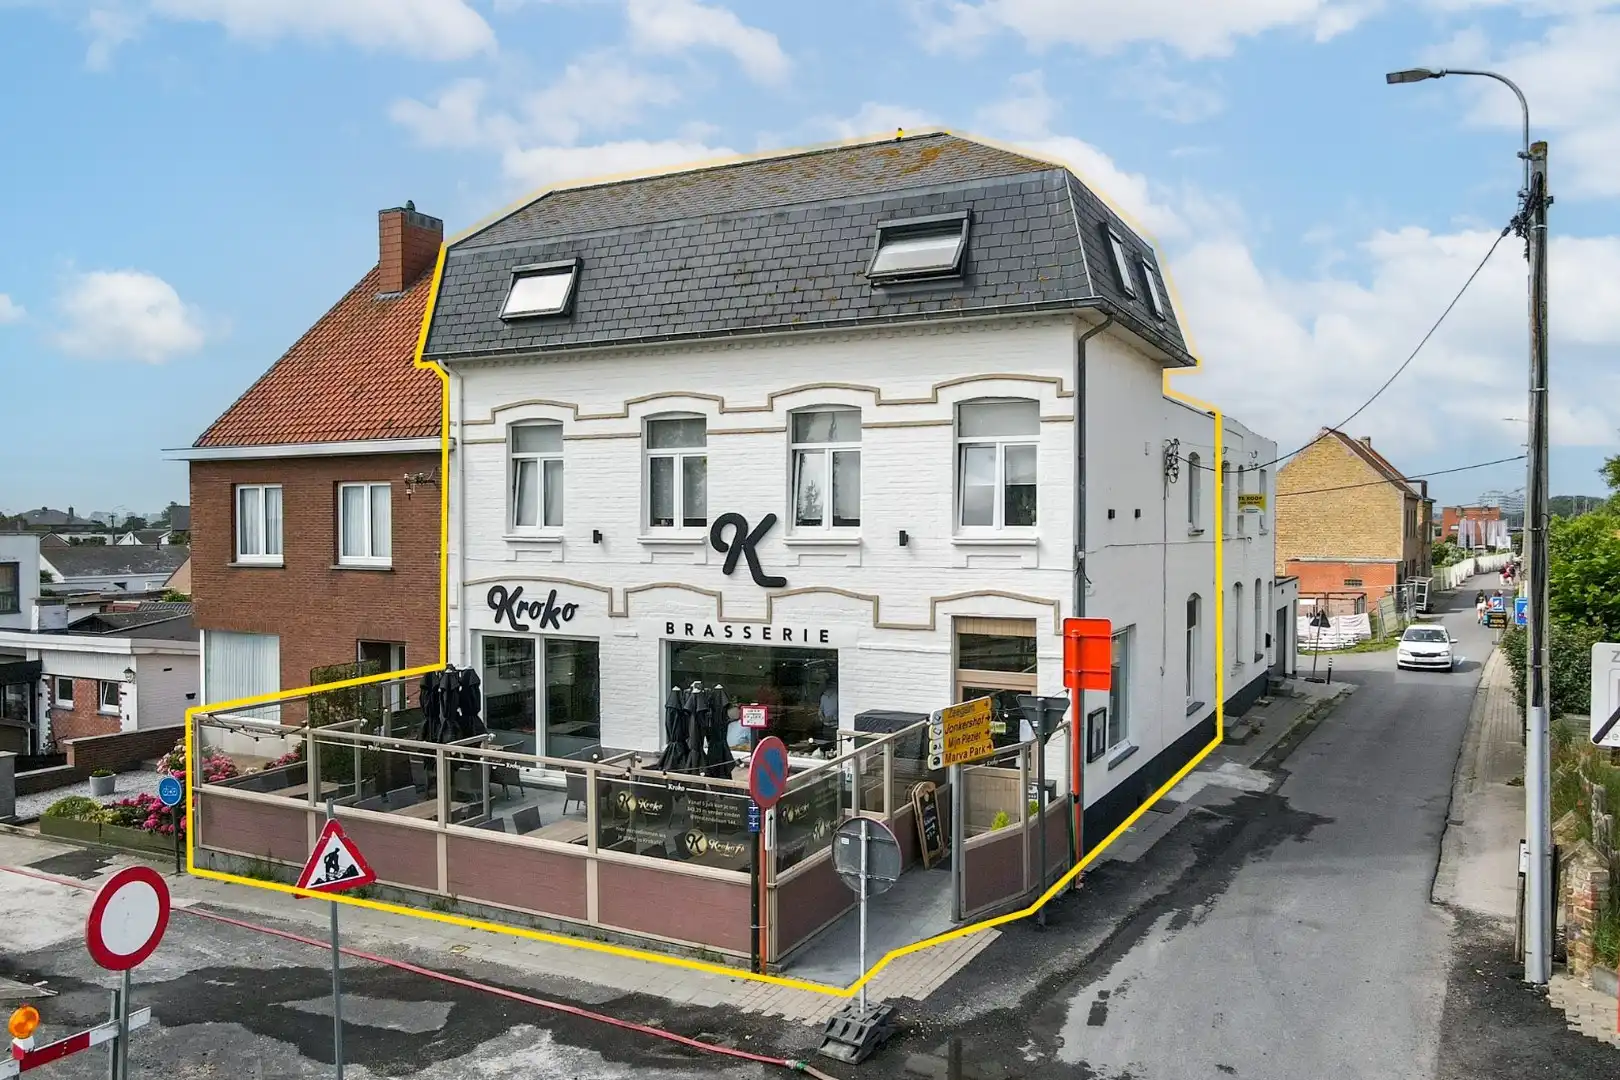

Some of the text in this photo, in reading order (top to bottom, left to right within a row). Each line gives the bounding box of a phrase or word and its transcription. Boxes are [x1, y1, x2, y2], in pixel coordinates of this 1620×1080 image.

[710, 512, 787, 588] K
[487, 585, 580, 632] Kroko
[666, 622, 830, 643] BRASSERIE
[944, 714, 984, 735] Jonkershof
[948, 732, 981, 749] Mijn Plezier
[944, 745, 986, 764] Marva Park
[638, 797, 663, 812] Kroko
